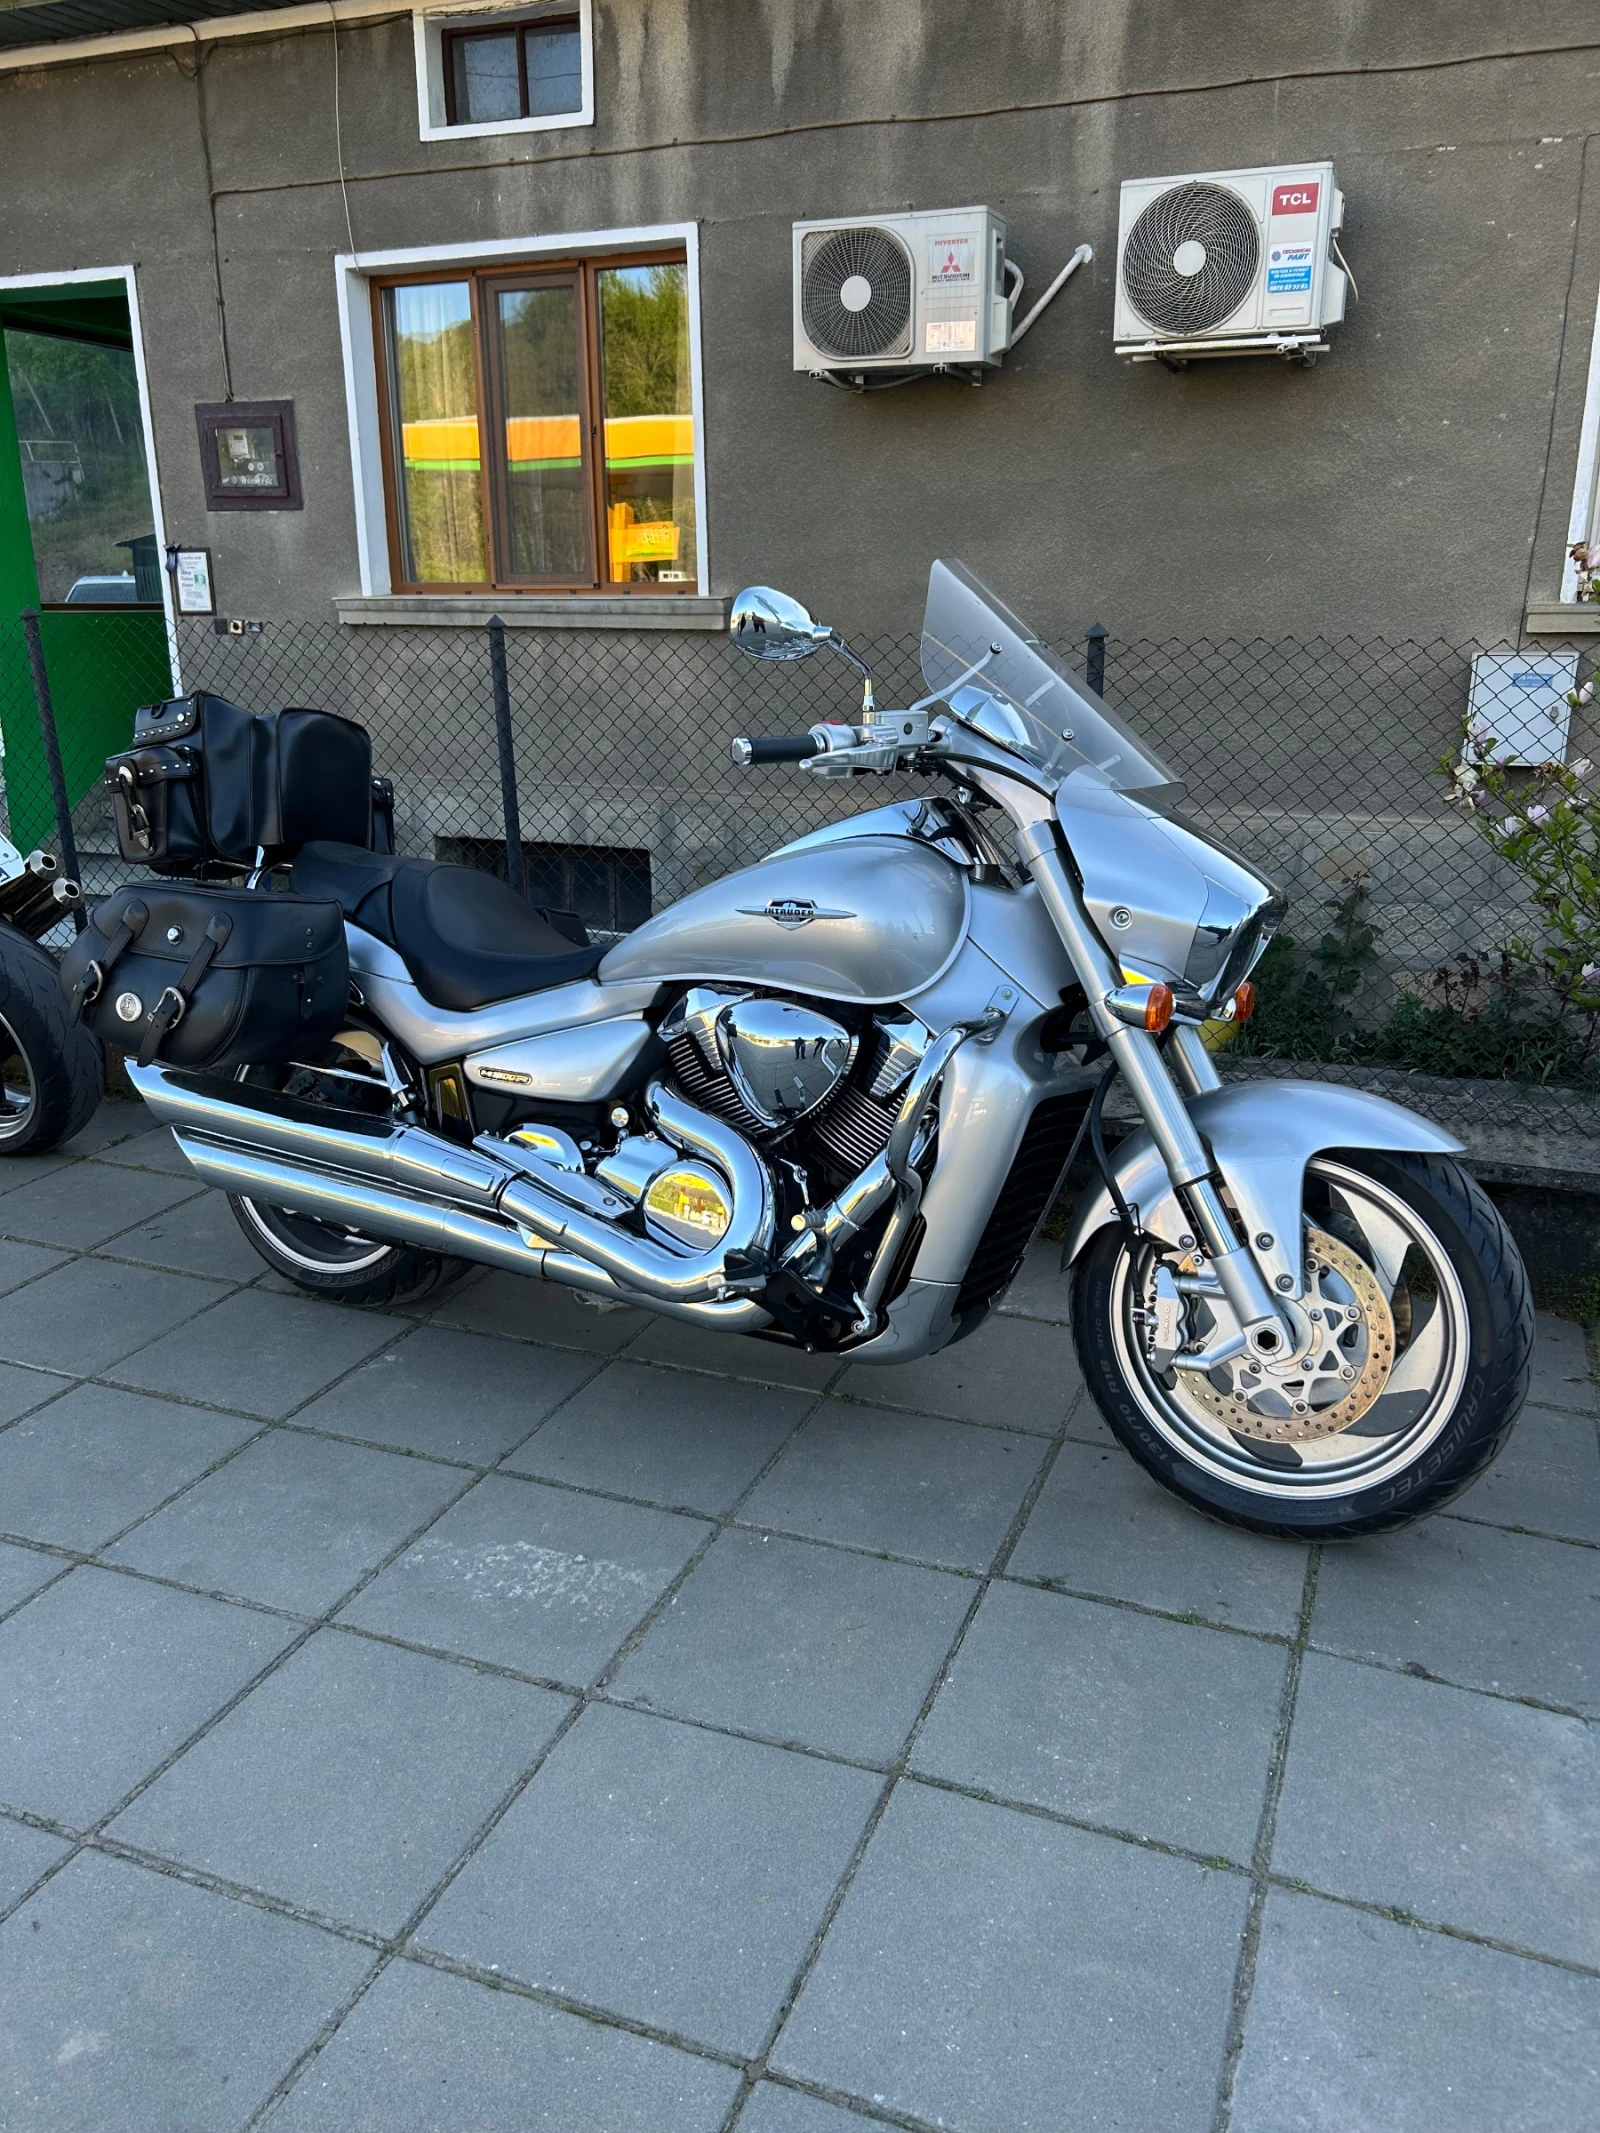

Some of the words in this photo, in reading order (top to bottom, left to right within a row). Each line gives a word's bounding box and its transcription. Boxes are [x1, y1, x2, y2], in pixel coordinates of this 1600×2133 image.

[1279, 193, 1312, 206] TCL
[934, 238, 969, 246] INVERTER
[763, 907, 815, 917] INTRUDER
[307, 1248, 401, 1286] CRUISETEC
[1163, 1303, 1172, 1342] TOKICO
[1118, 1403, 1171, 1462] 130/70
[1379, 1373, 1486, 1506] CRUISETEC
